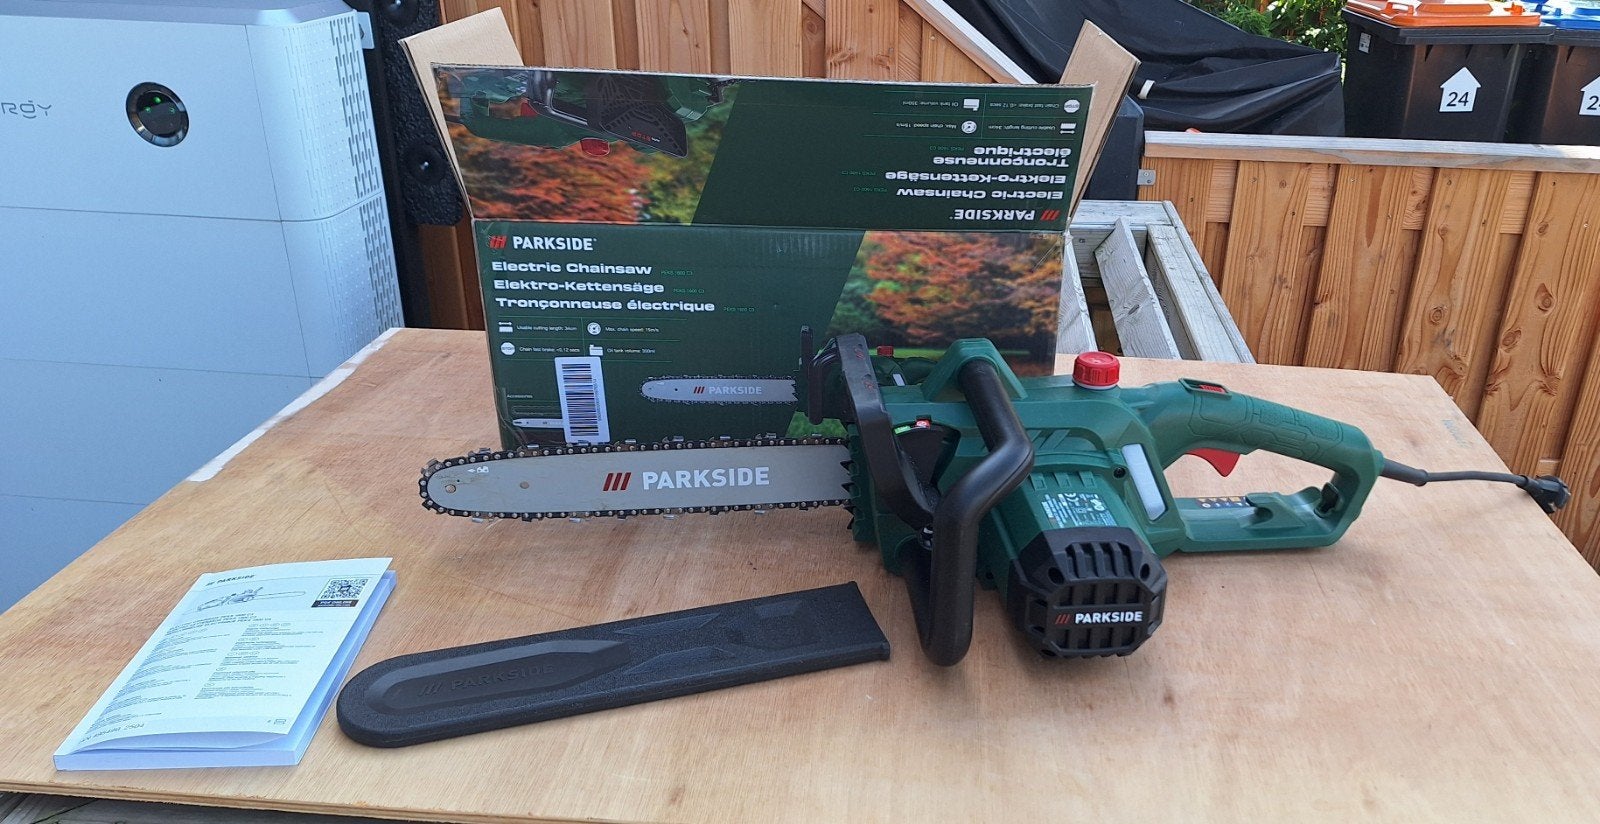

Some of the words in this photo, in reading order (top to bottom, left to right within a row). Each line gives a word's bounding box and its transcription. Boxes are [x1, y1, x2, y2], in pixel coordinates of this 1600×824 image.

[1446, 92, 1469, 107] 24
[1586, 95, 1600, 110] 2
[974, 146, 1072, 156] électrique
[933, 156, 1069, 167] Tronçonneuse
[885, 171, 1066, 184] Elektro-Kettensäge
[896, 188, 986, 199] Chainsaw
[991, 190, 1064, 200] Electric
[954, 209, 1035, 220] PARKSIDE
[512, 236, 593, 251] PARKSIDE
[492, 261, 561, 272] Electric
[566, 262, 652, 275] Chainsaw
[494, 280, 664, 294] Elektro-Kettensäge
[495, 297, 622, 310] Tronçonneuse
[627, 299, 715, 312] électrique
[708, 386, 762, 395] PARKSIDE
[642, 466, 770, 490] PARKSIDE
[1075, 611, 1143, 624] PARKSIDE
[451, 664, 554, 690] PARKSIDE
